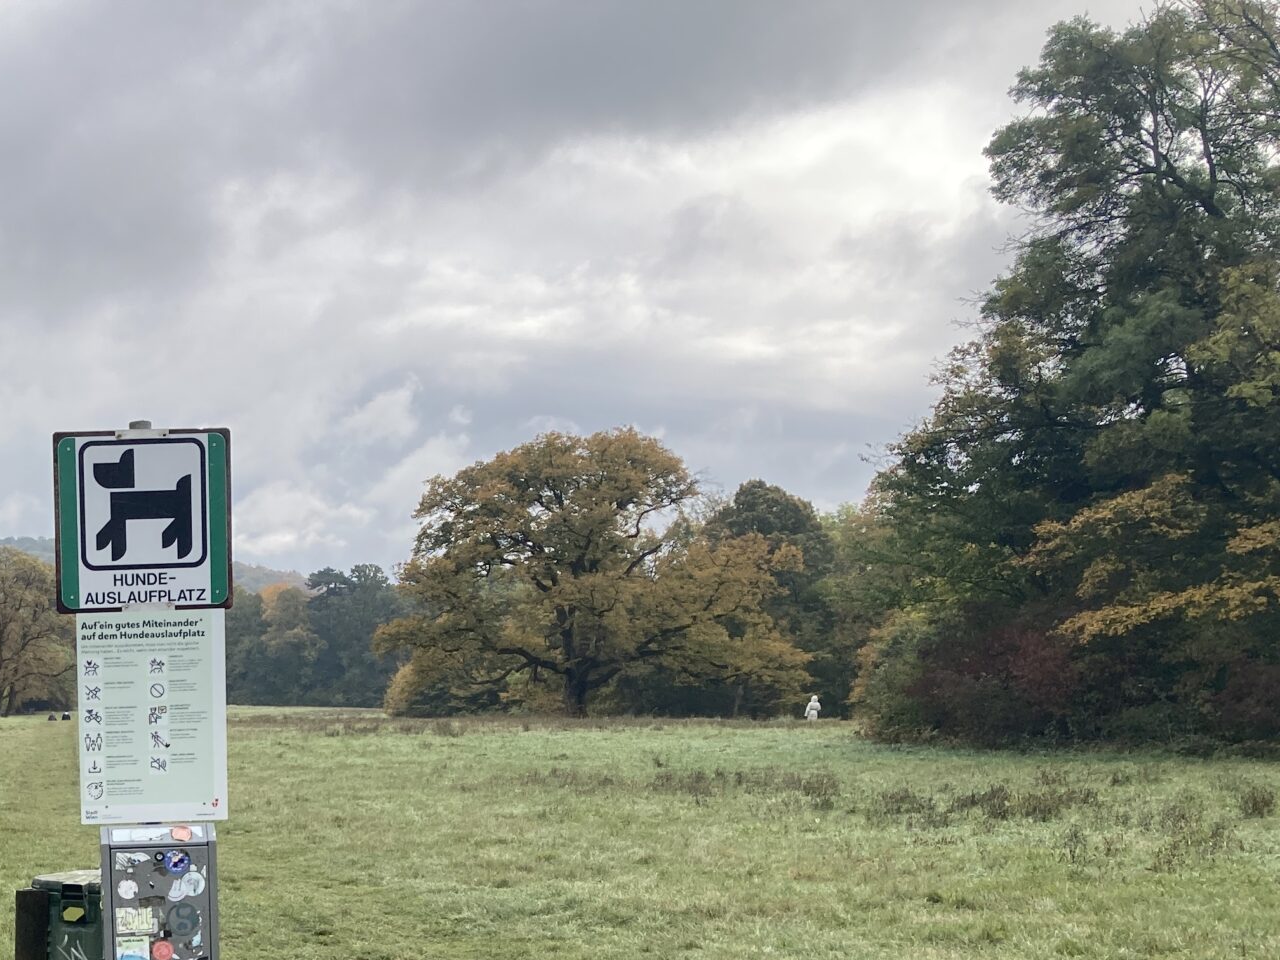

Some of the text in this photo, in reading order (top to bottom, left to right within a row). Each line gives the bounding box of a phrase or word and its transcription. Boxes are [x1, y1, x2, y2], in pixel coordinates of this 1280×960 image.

[113, 572, 177, 587] HUNDE-
[84, 588, 207, 605] AUSLAUFPLATZ
[81, 618, 199, 632] Auf ein gutes Miteinander
[81, 628, 206, 641] auf dem Hundeauslaufplatz
